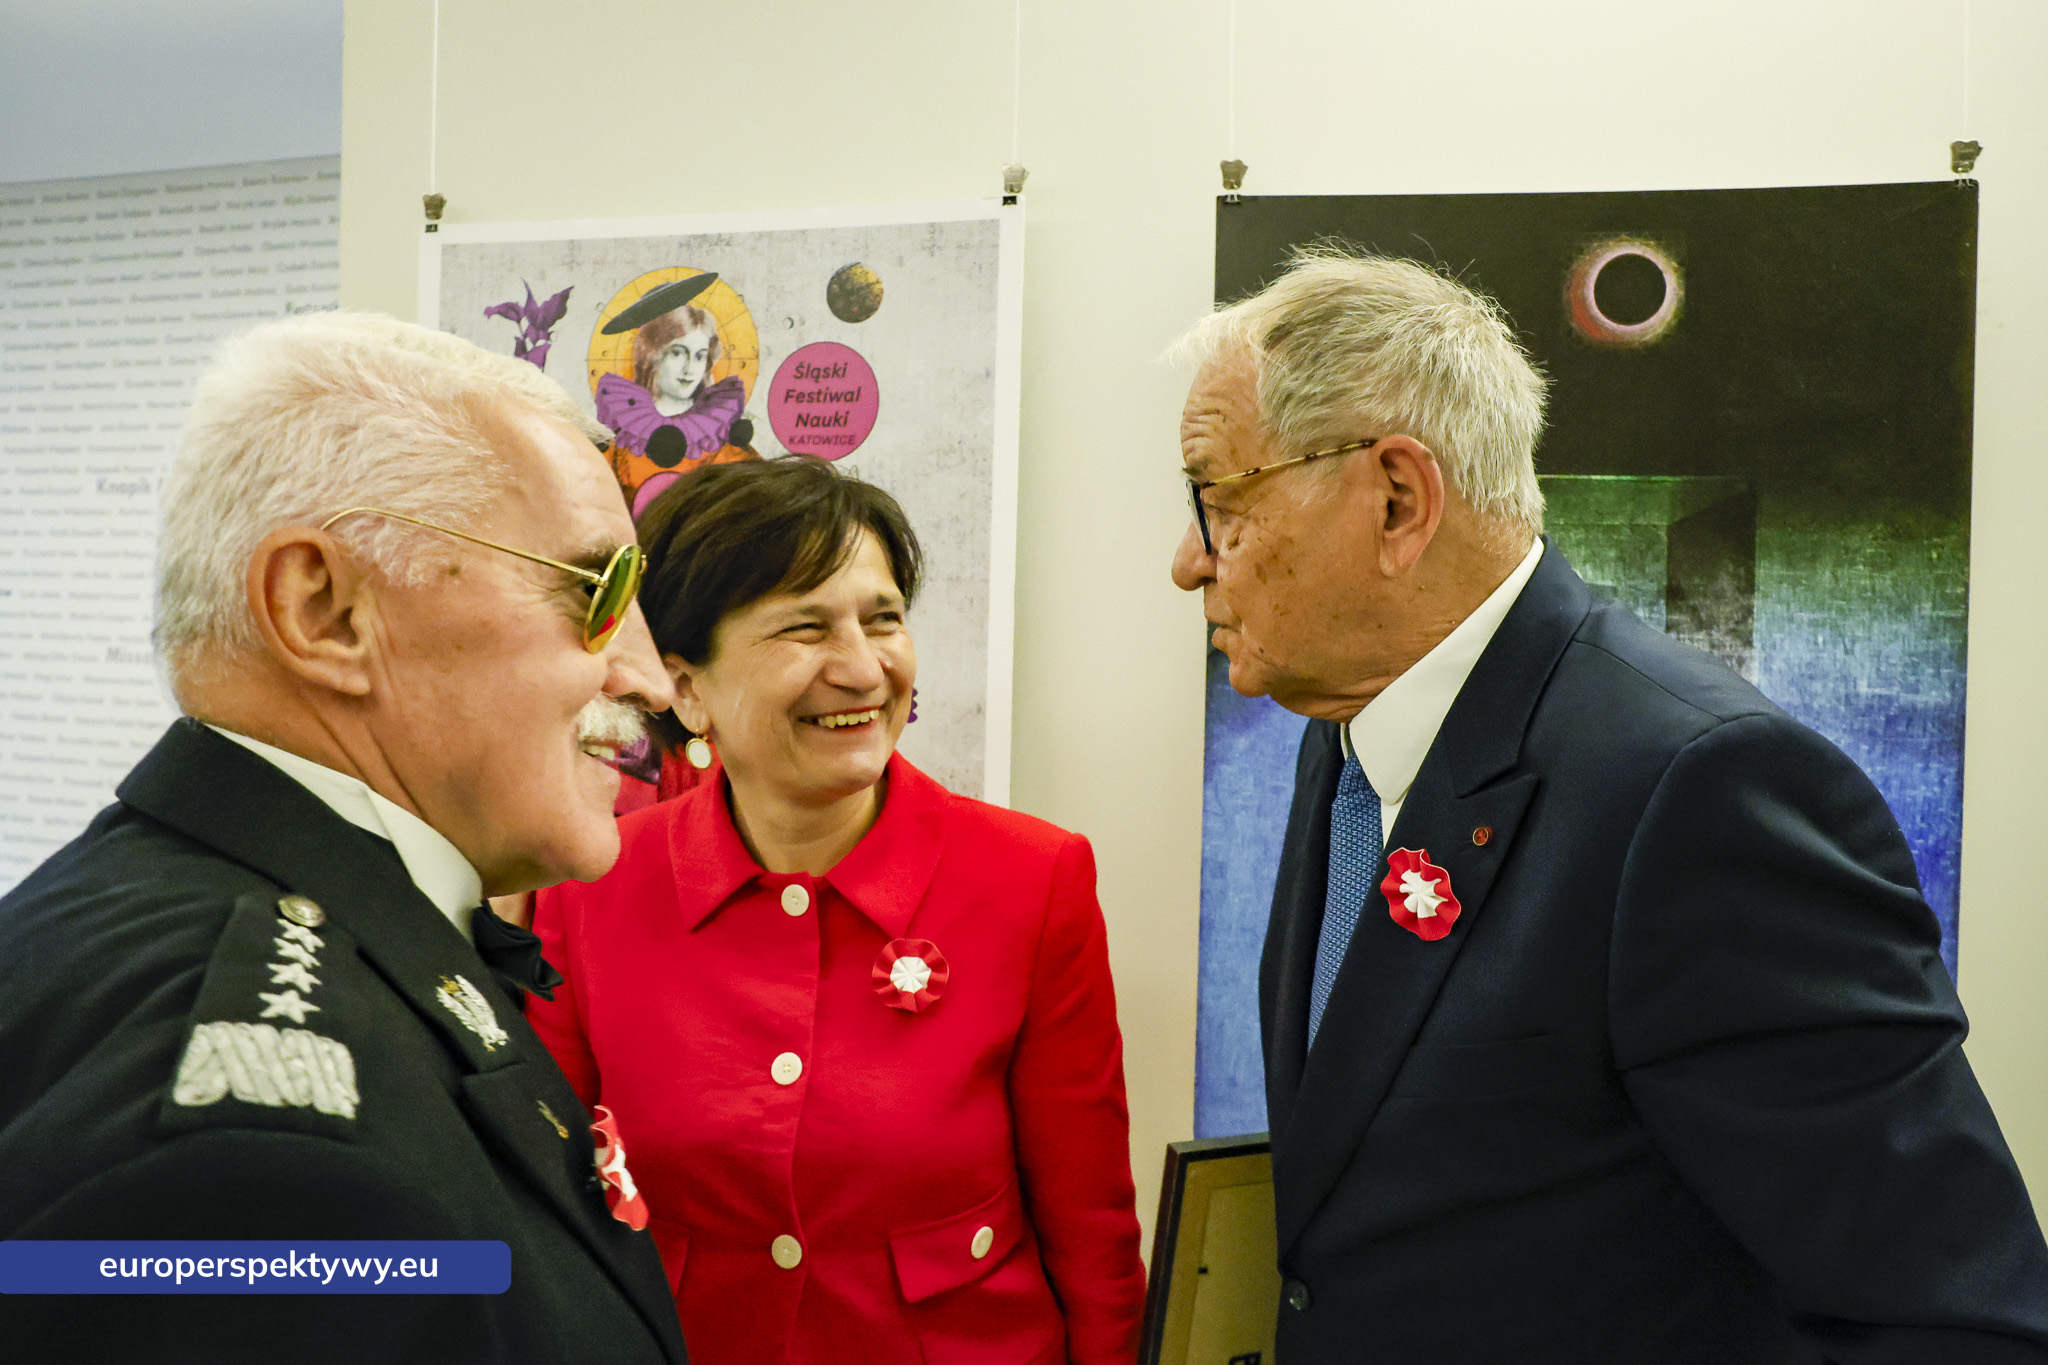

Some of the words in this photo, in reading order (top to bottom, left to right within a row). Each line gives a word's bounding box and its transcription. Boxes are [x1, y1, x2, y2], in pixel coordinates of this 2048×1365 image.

[793, 361, 848, 383] Śląski
[783, 385, 862, 404] Festiwal
[795, 411, 849, 428] Nauki
[788, 433, 857, 446] KATOWICE
